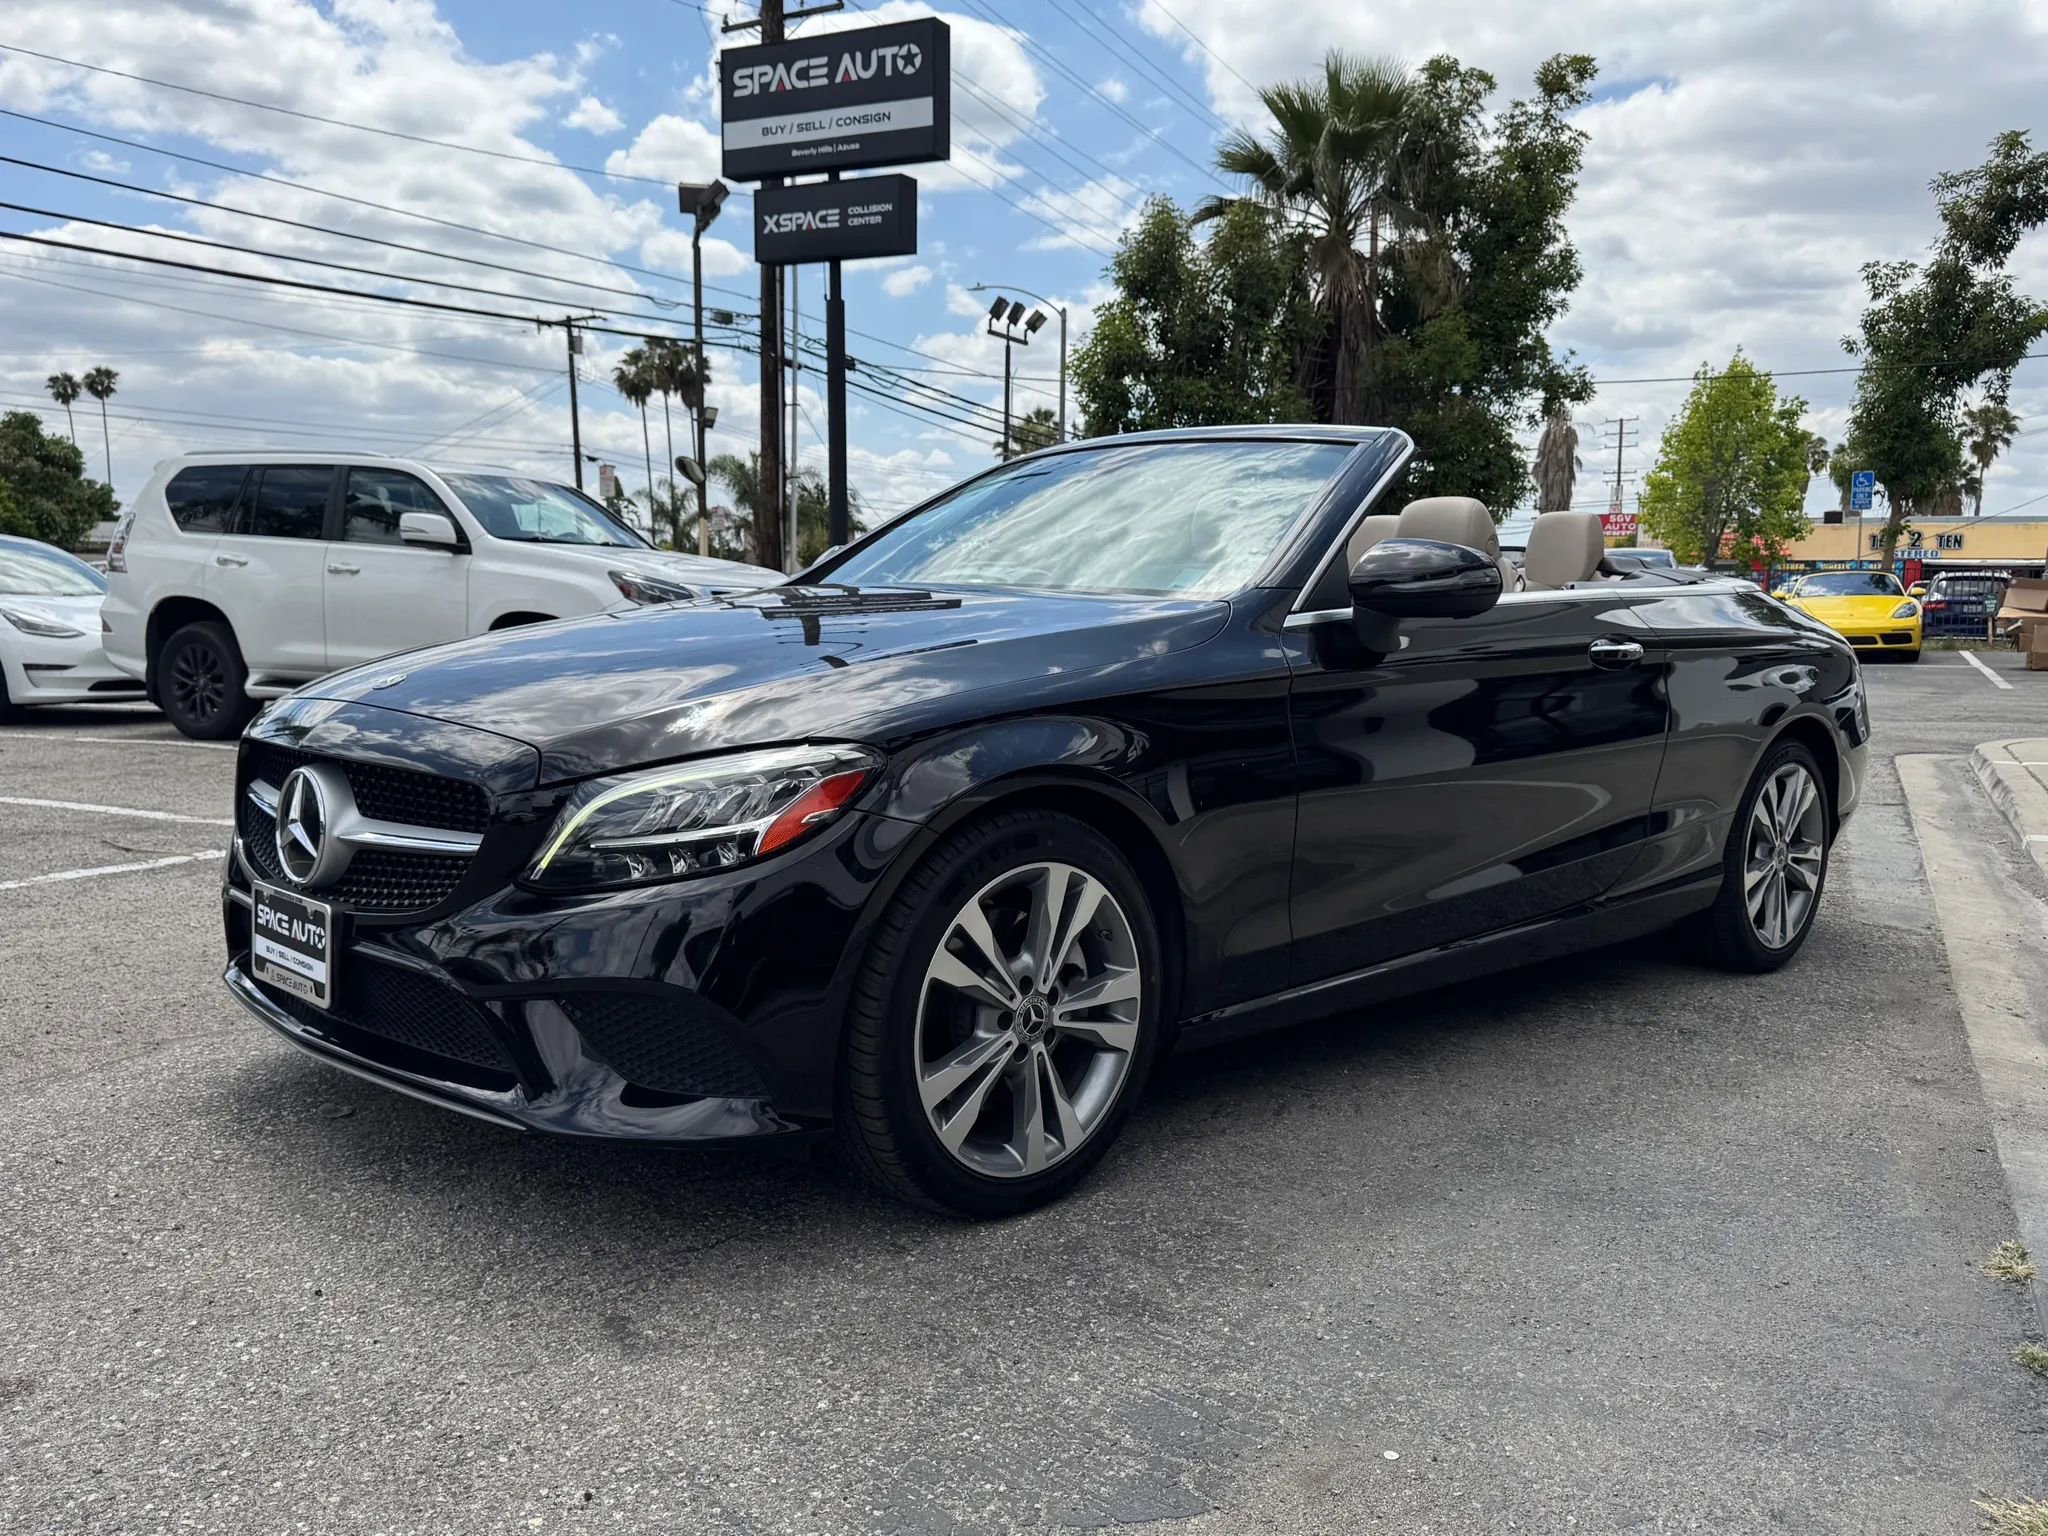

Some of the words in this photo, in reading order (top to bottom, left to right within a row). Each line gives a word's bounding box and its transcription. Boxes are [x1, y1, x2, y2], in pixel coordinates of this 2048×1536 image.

[733, 56, 829, 98] SPACE
[834, 43, 922, 83] AUTO
[761, 124, 787, 137] BUY
[796, 120, 826, 133] SELL
[835, 112, 891, 128] CONSIGN
[791, 146, 817, 157] Beverly
[817, 144, 833, 154] Hills
[848, 203, 893, 215] COLLISION
[763, 208, 840, 235] XSPACE
[848, 215, 882, 226] CENTER
[1609, 514, 1632, 522] SGV
[1604, 522, 1636, 530] AUTO
[1908, 530, 1923, 549] 2
[1936, 533, 1963, 550] TEN
[1894, 549, 1941, 559] STEREO
[257, 904, 290, 936] SPACE
[291, 919, 326, 949] AUTO
[266, 945, 276, 955] BUY
[278, 949, 290, 962] SELL
